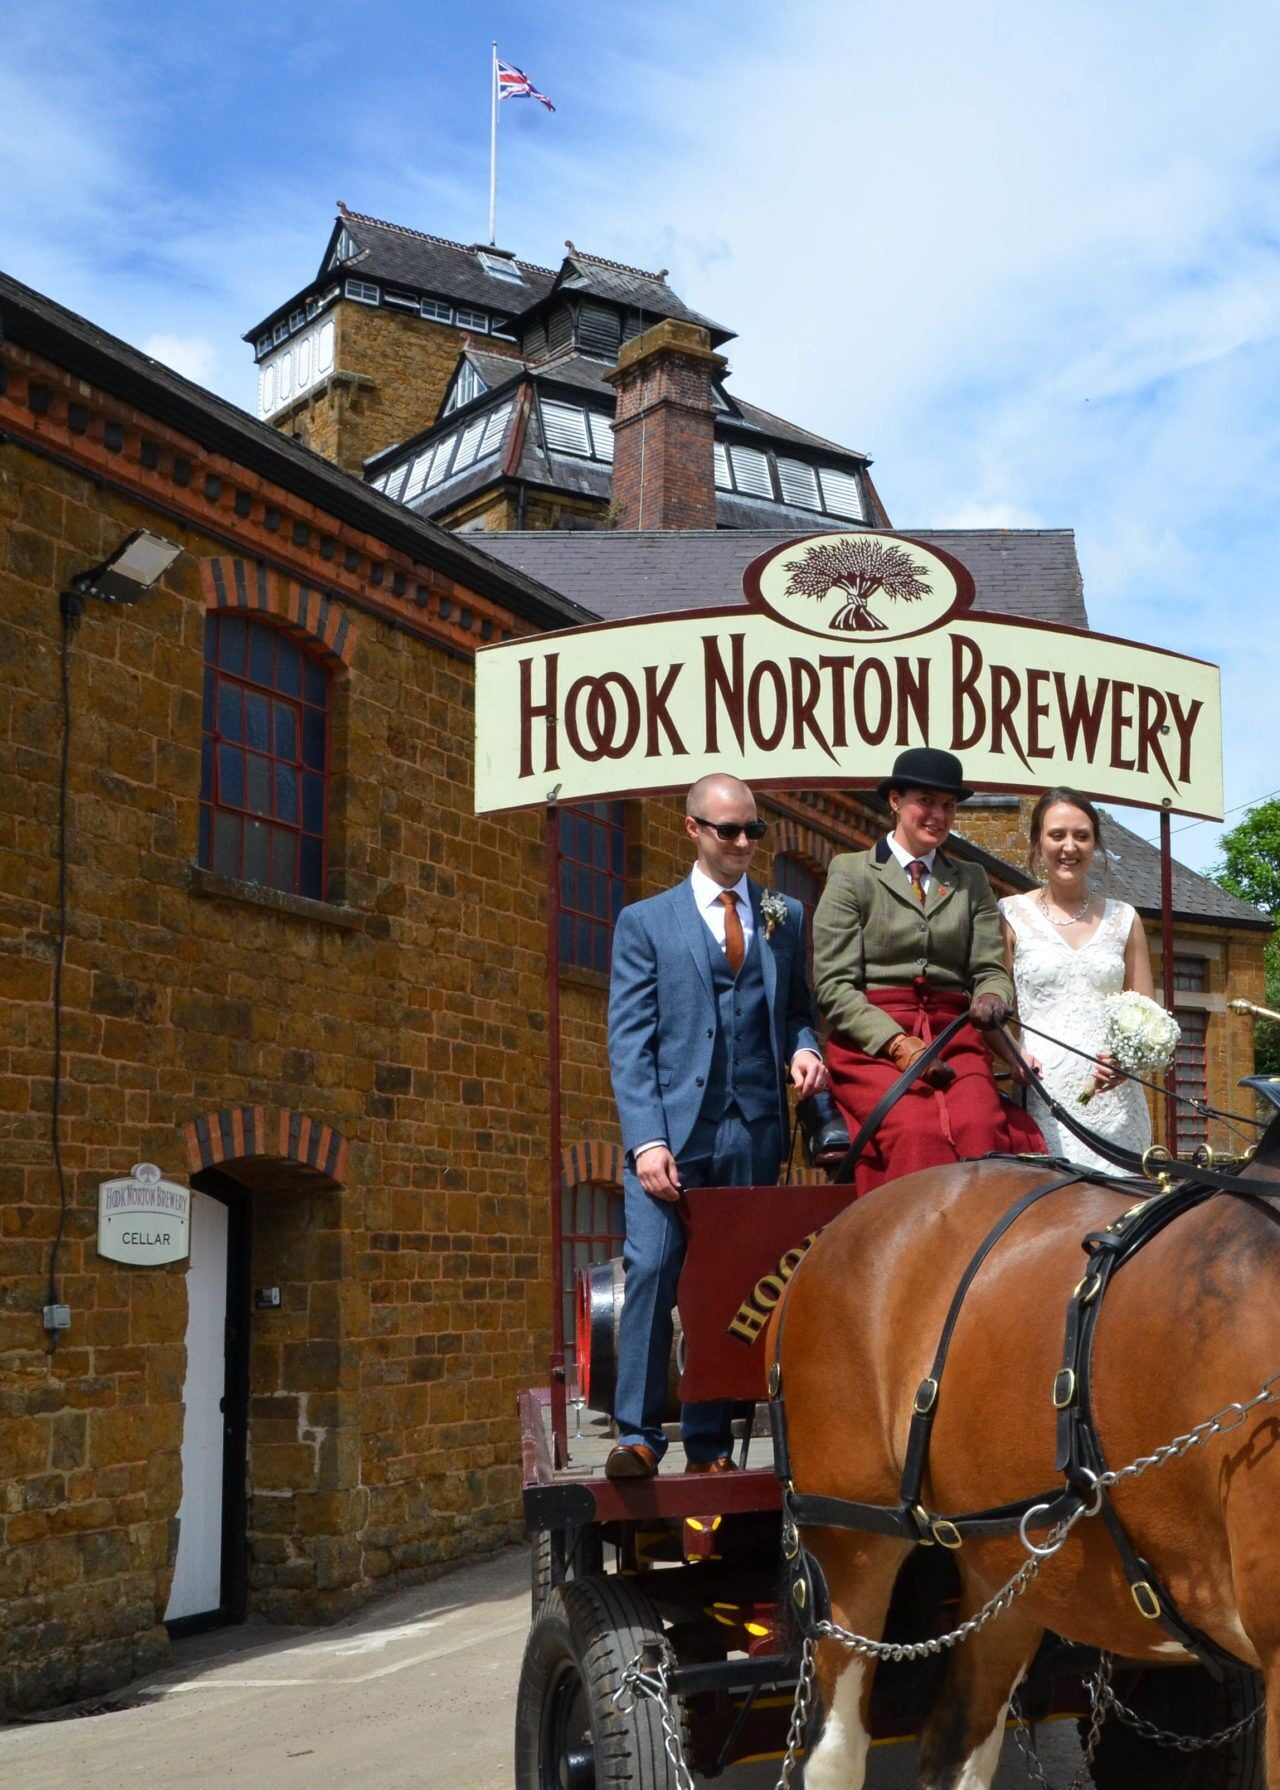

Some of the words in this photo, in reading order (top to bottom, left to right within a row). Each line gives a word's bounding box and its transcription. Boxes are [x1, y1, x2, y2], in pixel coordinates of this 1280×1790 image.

[519, 652, 690, 779] HOOK
[703, 632, 932, 767] NORTON
[949, 633, 1204, 798] BREWERY
[106, 1186, 128, 1210] HOOK
[127, 1184, 155, 1208] NORTON
[156, 1186, 188, 1213] BREWERY
[122, 1232, 171, 1246] CELLAR
[727, 1231, 817, 1344] HOO
